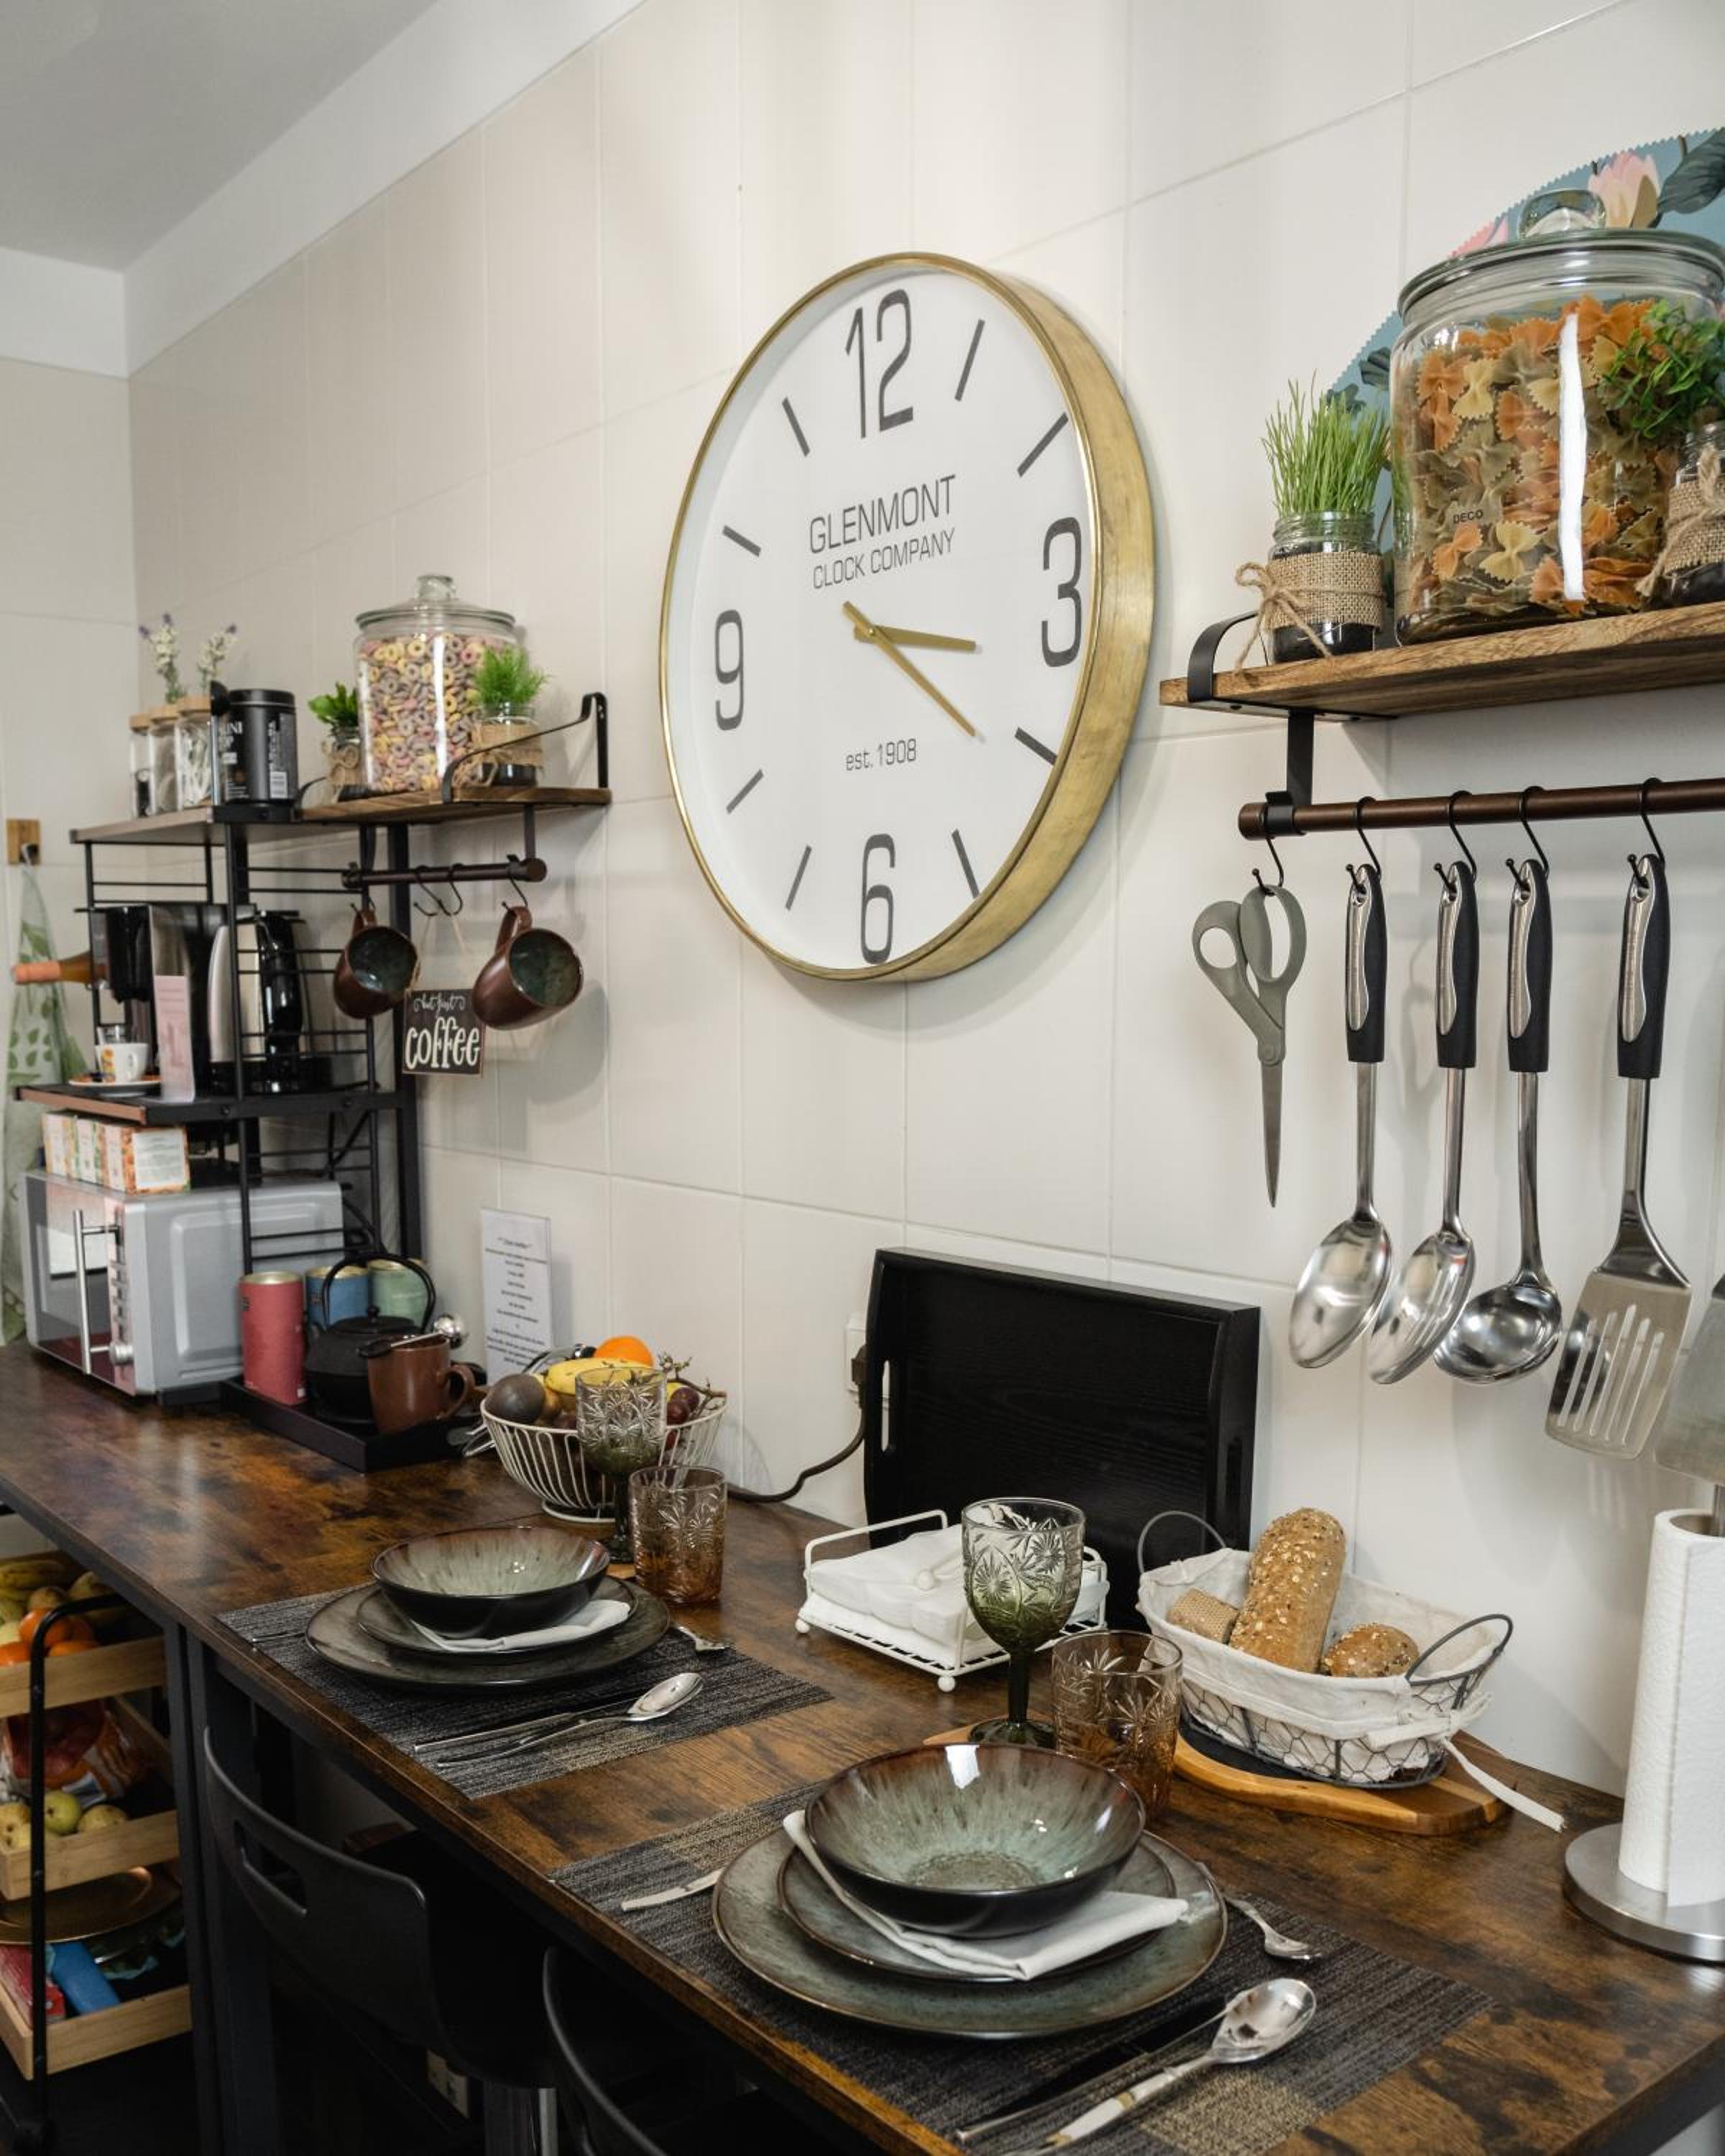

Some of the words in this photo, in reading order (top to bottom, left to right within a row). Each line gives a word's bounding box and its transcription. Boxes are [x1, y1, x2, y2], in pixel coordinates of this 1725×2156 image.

[845, 289, 914, 439] 12
[809, 474, 956, 554] GLENMONT
[1453, 509, 1484, 524] DECO
[813, 553, 866, 589] CLOCK
[870, 527, 956, 574] COMPANY
[1041, 517, 1082, 668] 3
[714, 609, 745, 731] 9
[876, 738, 916, 767] 1908
[860, 833, 896, 964] 6
[405, 1015, 481, 1070] coffee
